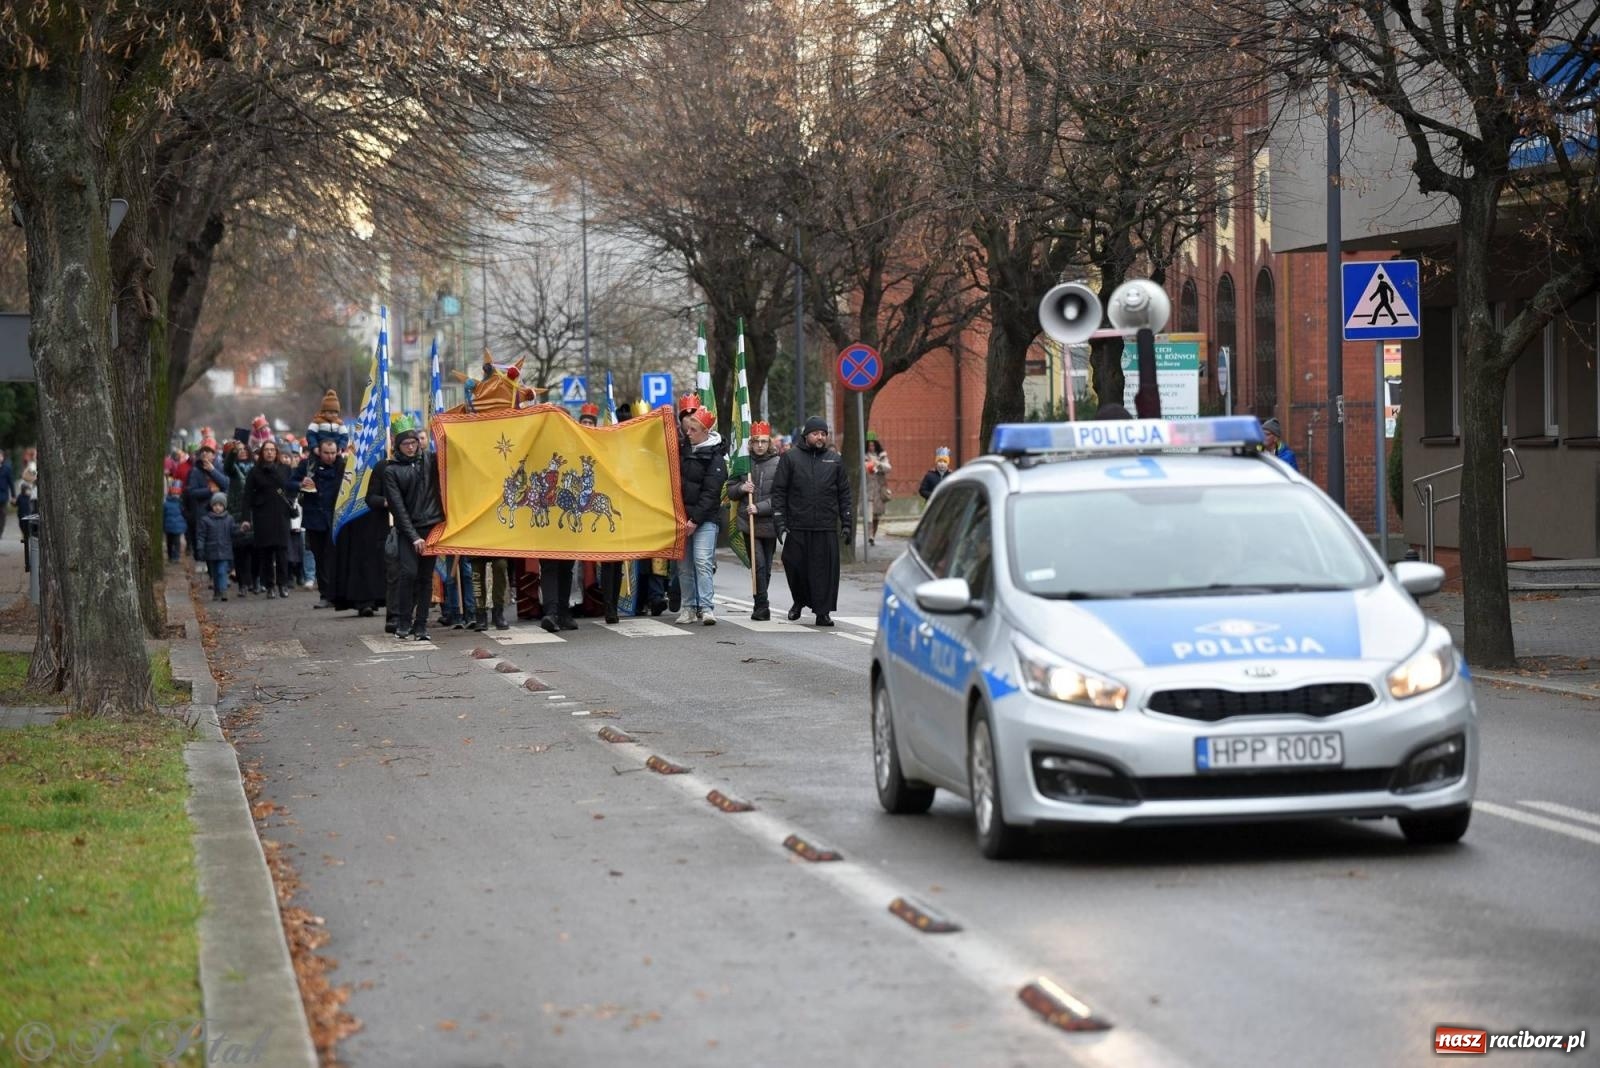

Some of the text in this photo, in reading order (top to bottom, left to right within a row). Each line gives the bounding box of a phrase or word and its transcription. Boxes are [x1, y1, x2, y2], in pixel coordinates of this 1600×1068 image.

[648, 377, 666, 403] P
[1079, 425, 1164, 445] POLICJA
[1171, 636, 1326, 660] POLICJA
[1212, 735, 1337, 763] HPP R005
